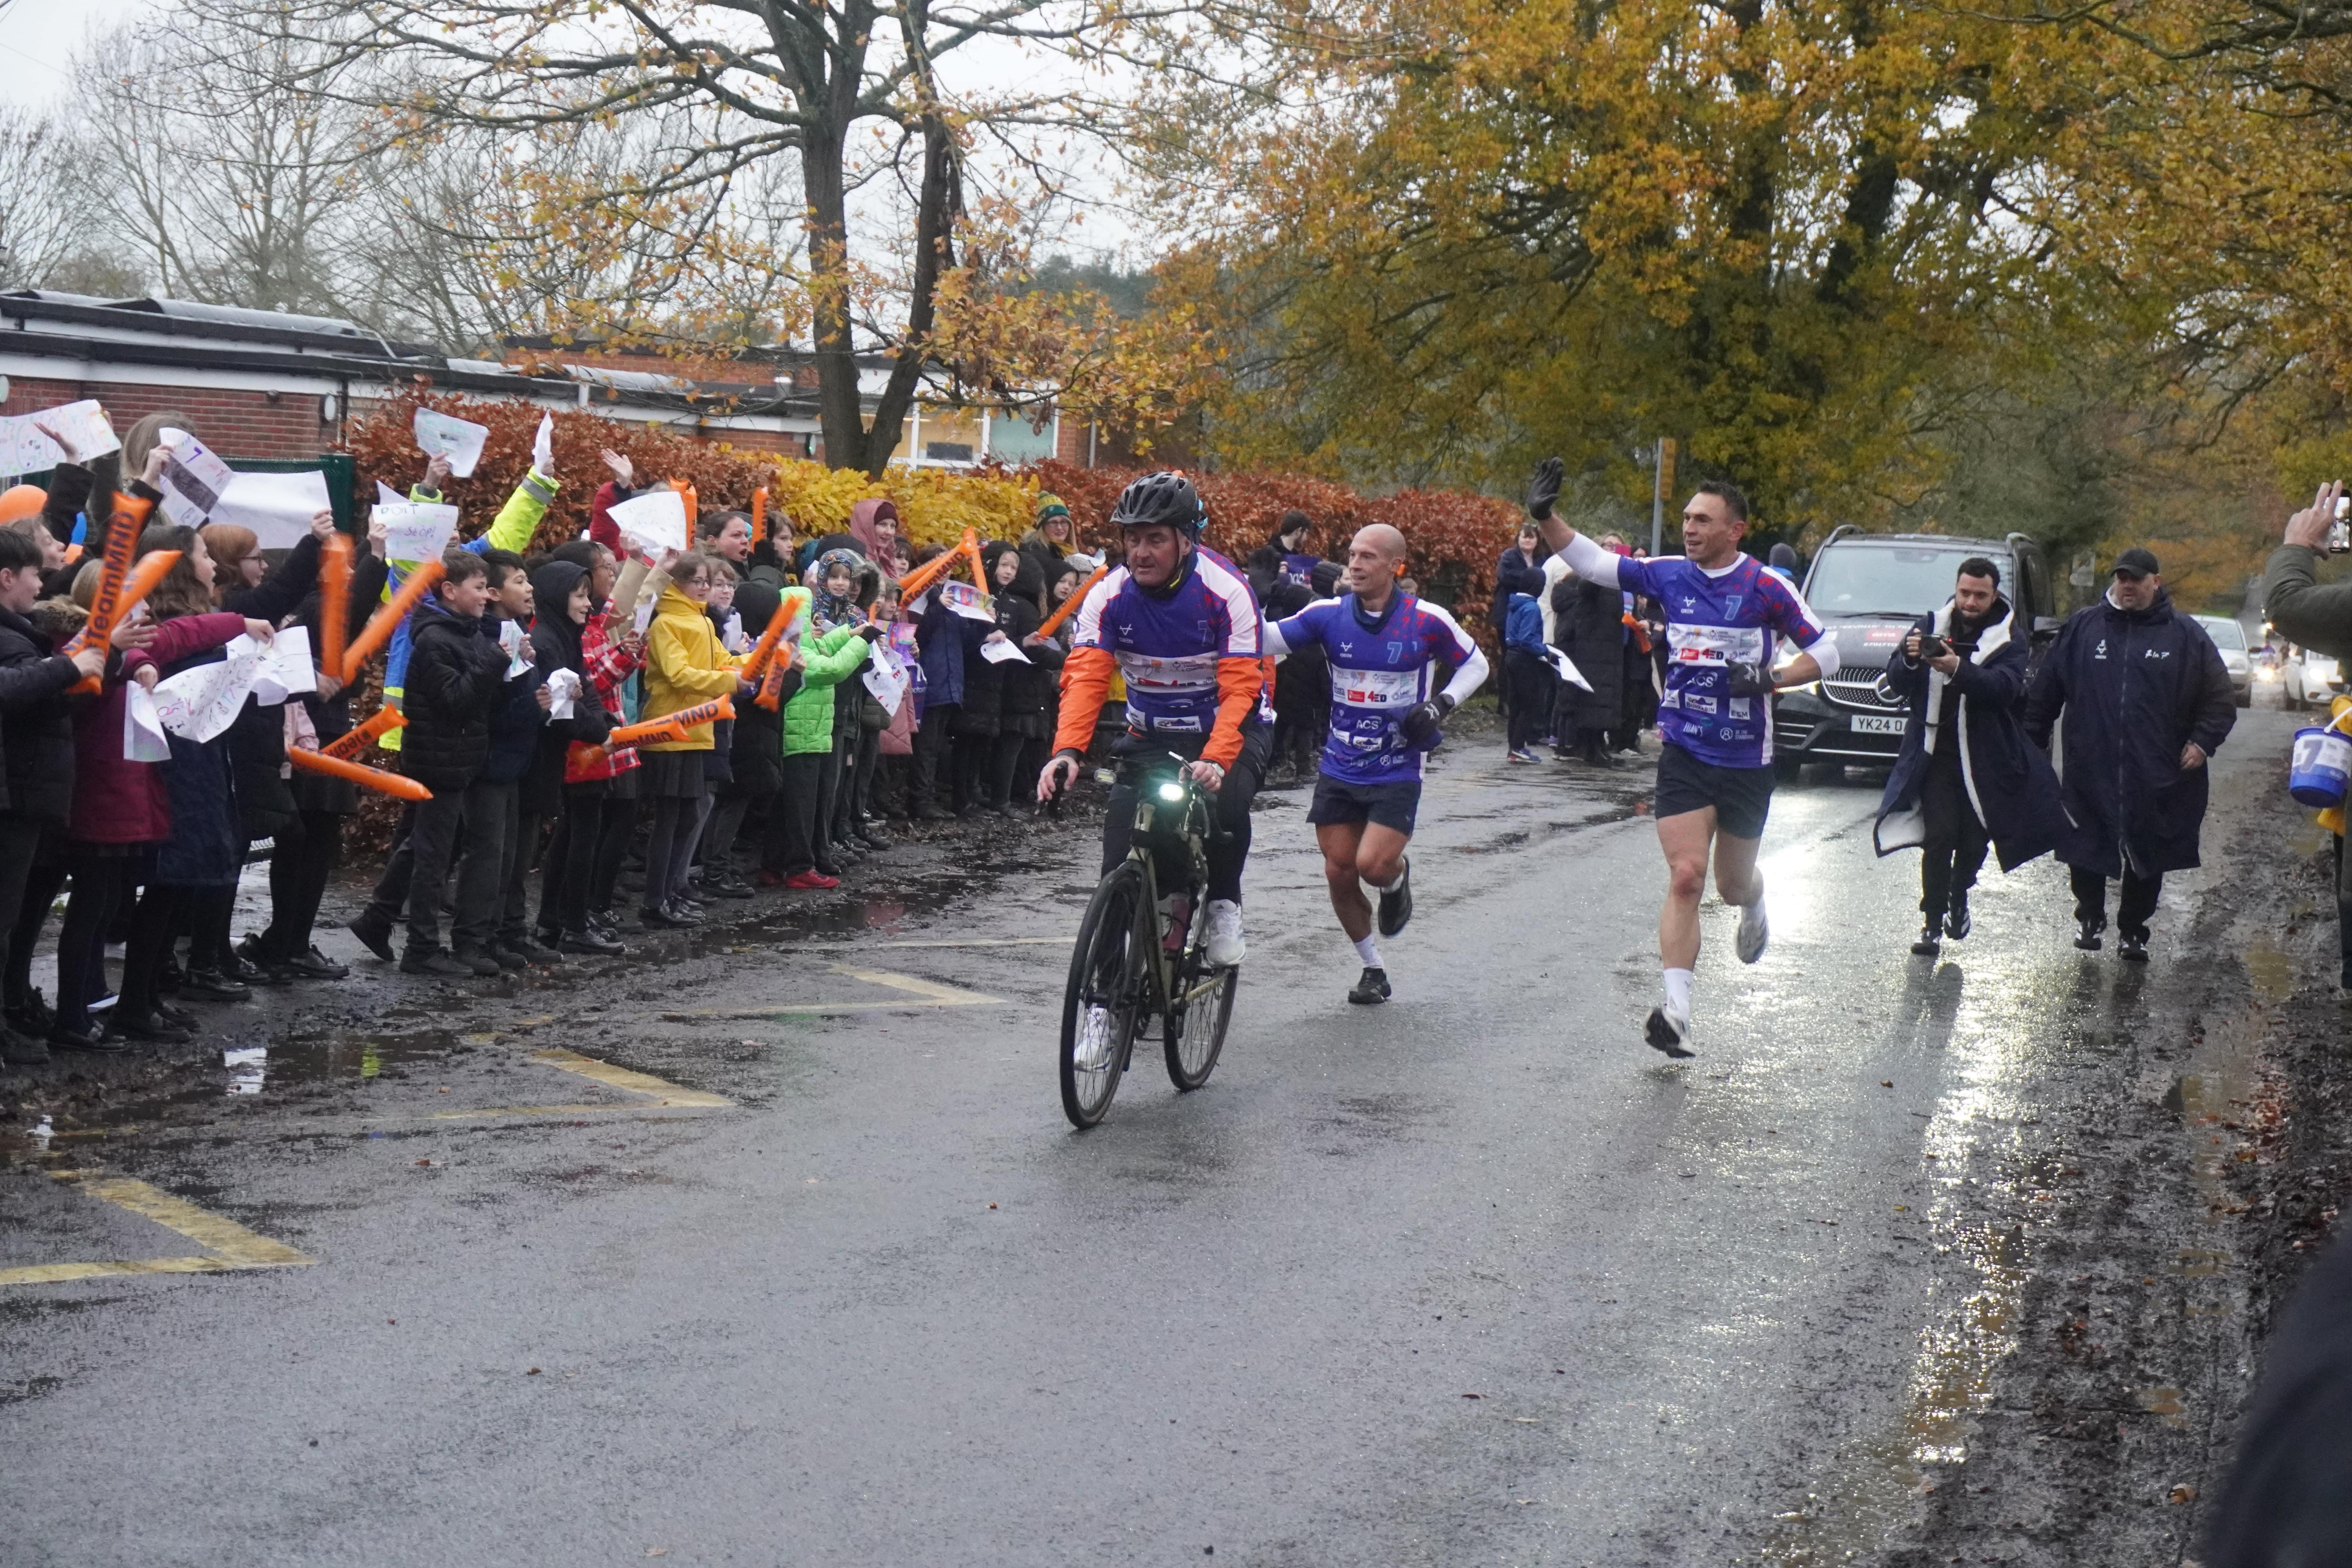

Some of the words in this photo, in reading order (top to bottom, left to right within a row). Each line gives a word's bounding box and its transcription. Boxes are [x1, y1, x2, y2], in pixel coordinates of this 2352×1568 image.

[1724, 595, 1742, 621] 7
[1387, 642, 1402, 664] 7
[1356, 719, 1379, 730] ACS
[1858, 717, 1891, 731] YK24
